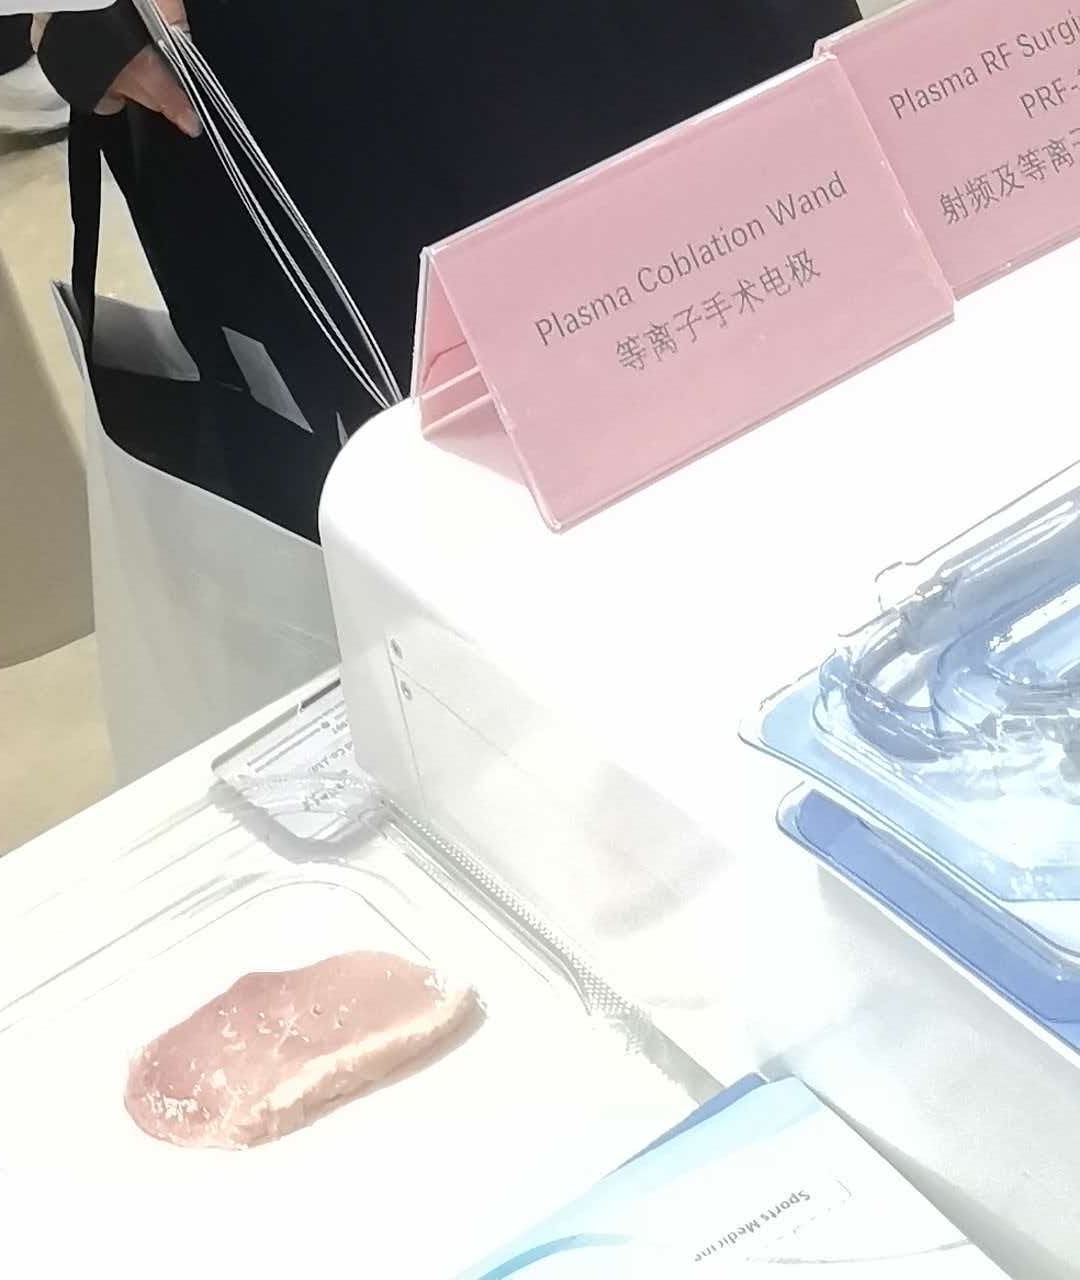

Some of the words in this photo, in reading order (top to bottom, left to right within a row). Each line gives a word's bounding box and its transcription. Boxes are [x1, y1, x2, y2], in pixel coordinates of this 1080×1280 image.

[888, 65, 979, 120] Plasma
[980, 42, 1013, 75] RF
[1020, 68, 1080, 119] PRF-
[533, 285, 633, 346] Plasma
[637, 217, 767, 294] Coblation
[765, 170, 848, 227] Wand
[615, 248, 822, 372] 等离子手术电极
[760, 1189, 811, 1222] Sports
[694, 1219, 761, 1263] Medicine
